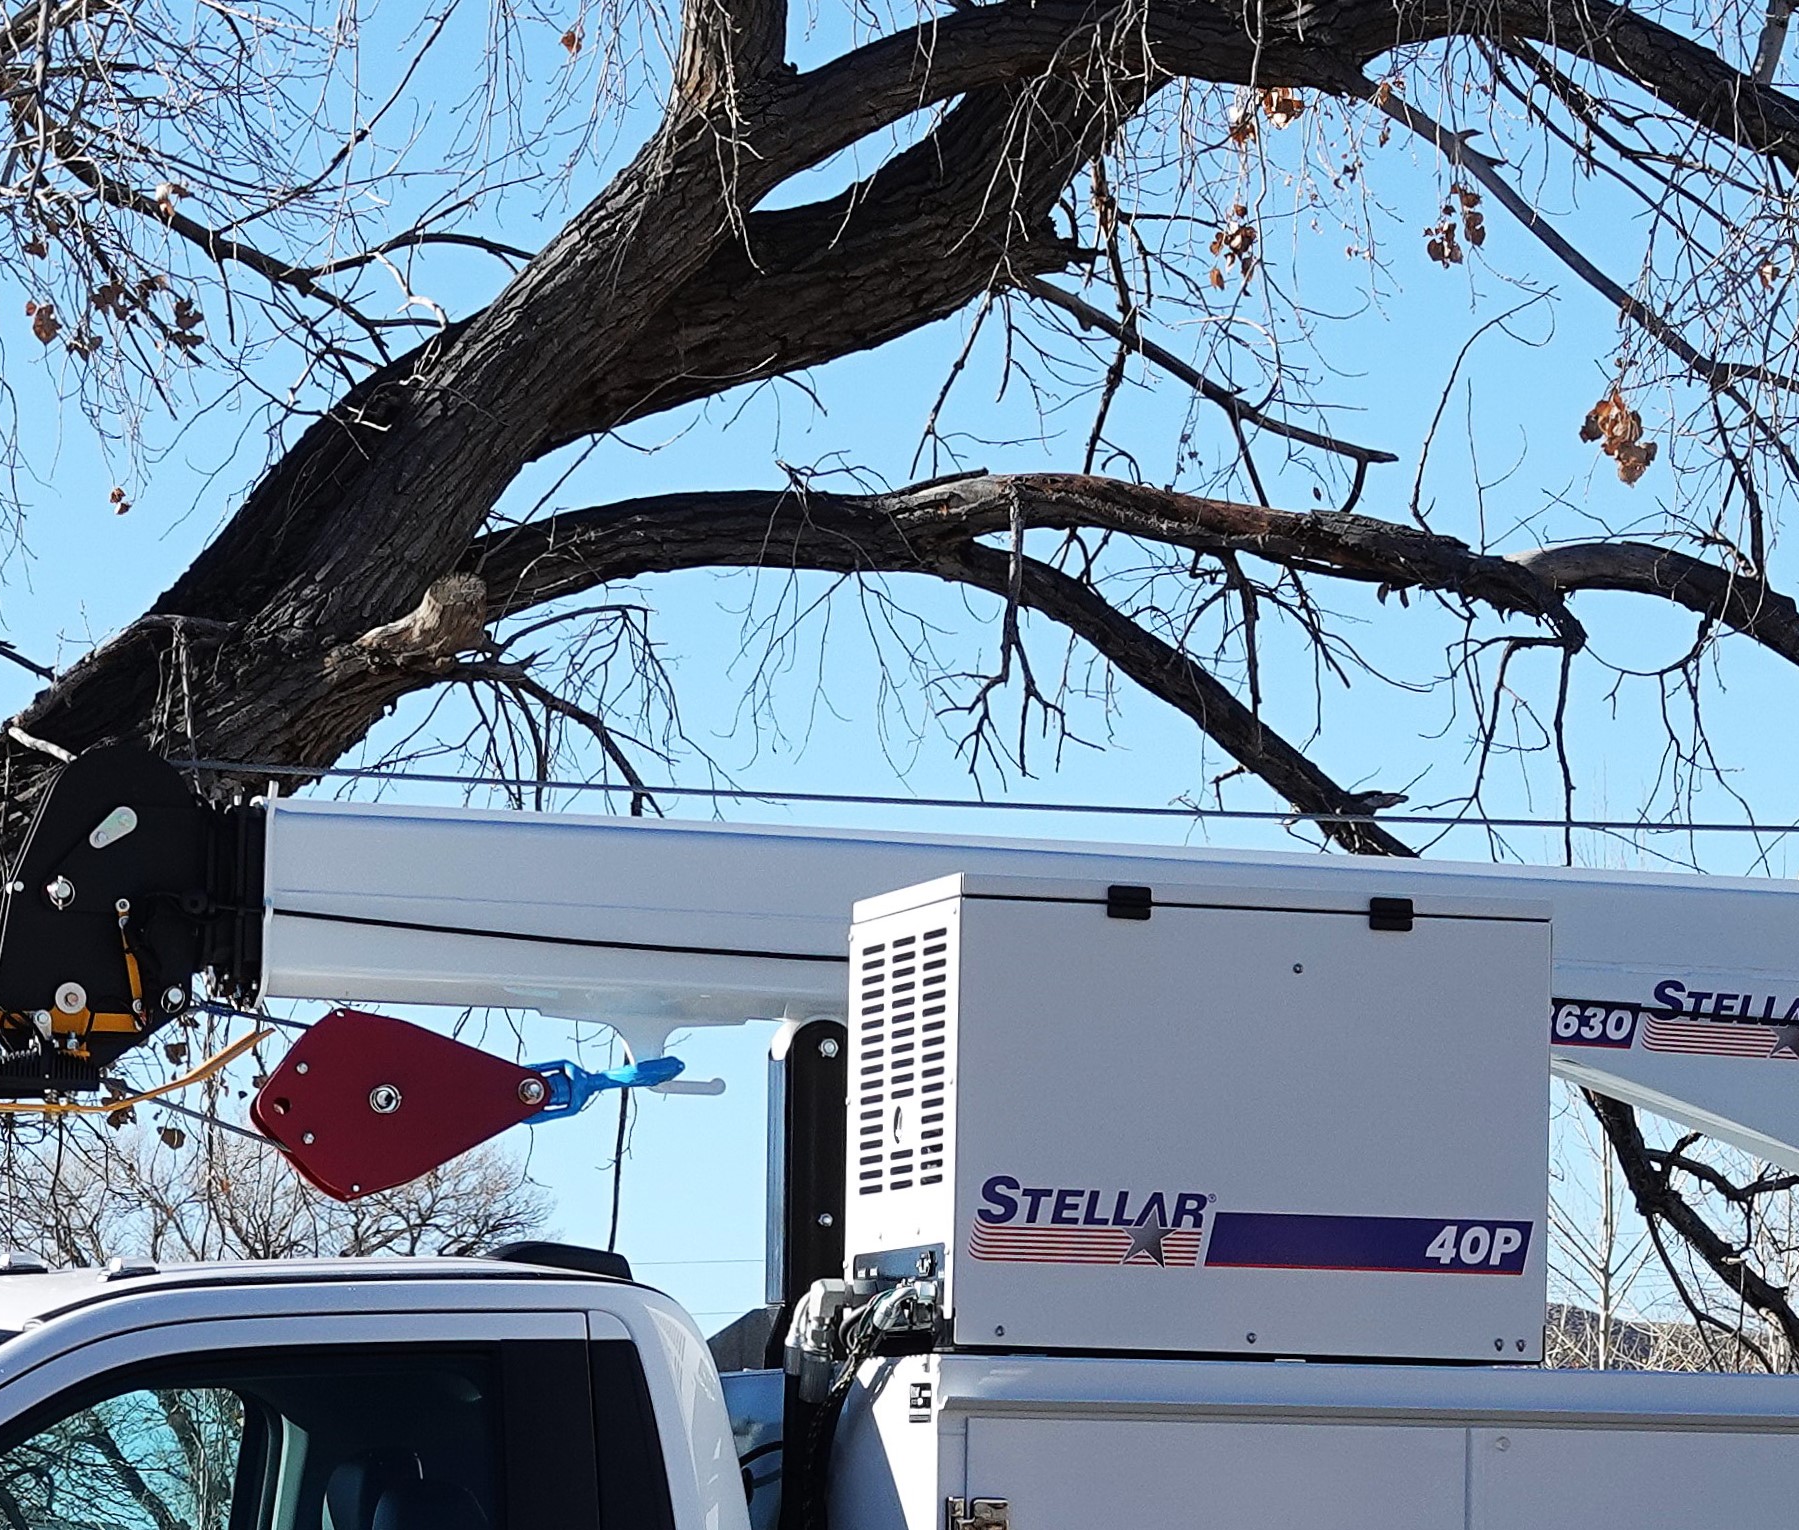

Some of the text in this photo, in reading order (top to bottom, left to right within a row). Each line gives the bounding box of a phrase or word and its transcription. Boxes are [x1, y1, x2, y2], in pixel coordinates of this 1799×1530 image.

[1550, 1004, 1633, 1040] 630
[977, 1175, 1208, 1228] STELLAR
[1425, 1225, 1522, 1265] 40P
